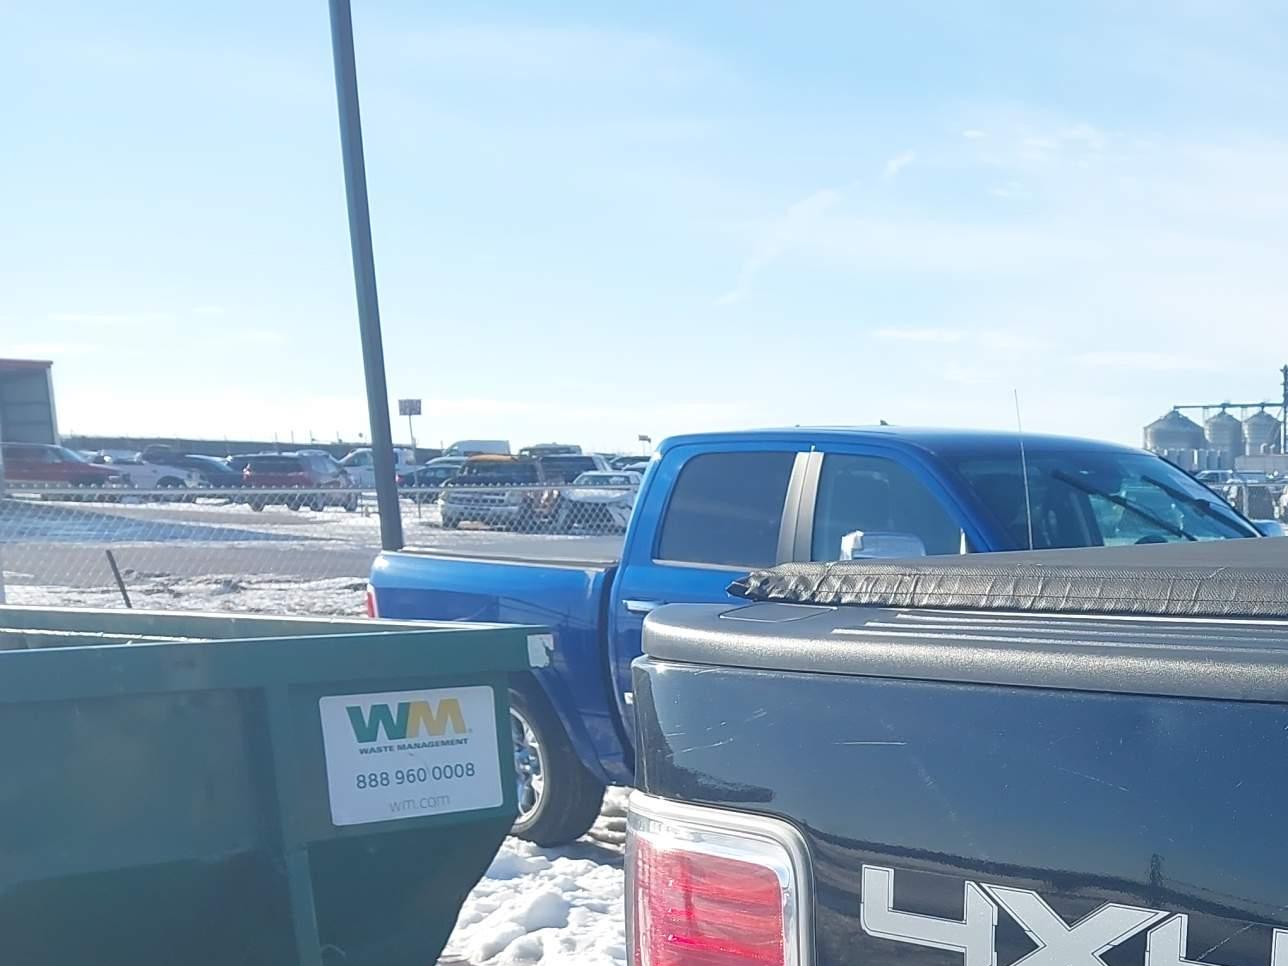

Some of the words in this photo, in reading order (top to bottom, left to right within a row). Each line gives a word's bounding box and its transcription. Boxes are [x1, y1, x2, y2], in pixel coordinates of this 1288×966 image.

[346, 698, 466, 743] WM
[359, 745, 395, 755] WASTE
[397, 738, 468, 751] MANAGEMENT
[356, 771, 390, 789] 888
[395, 767, 427, 785] 960
[432, 762, 475, 781] 0008
[390, 795, 451, 812] wm.com
